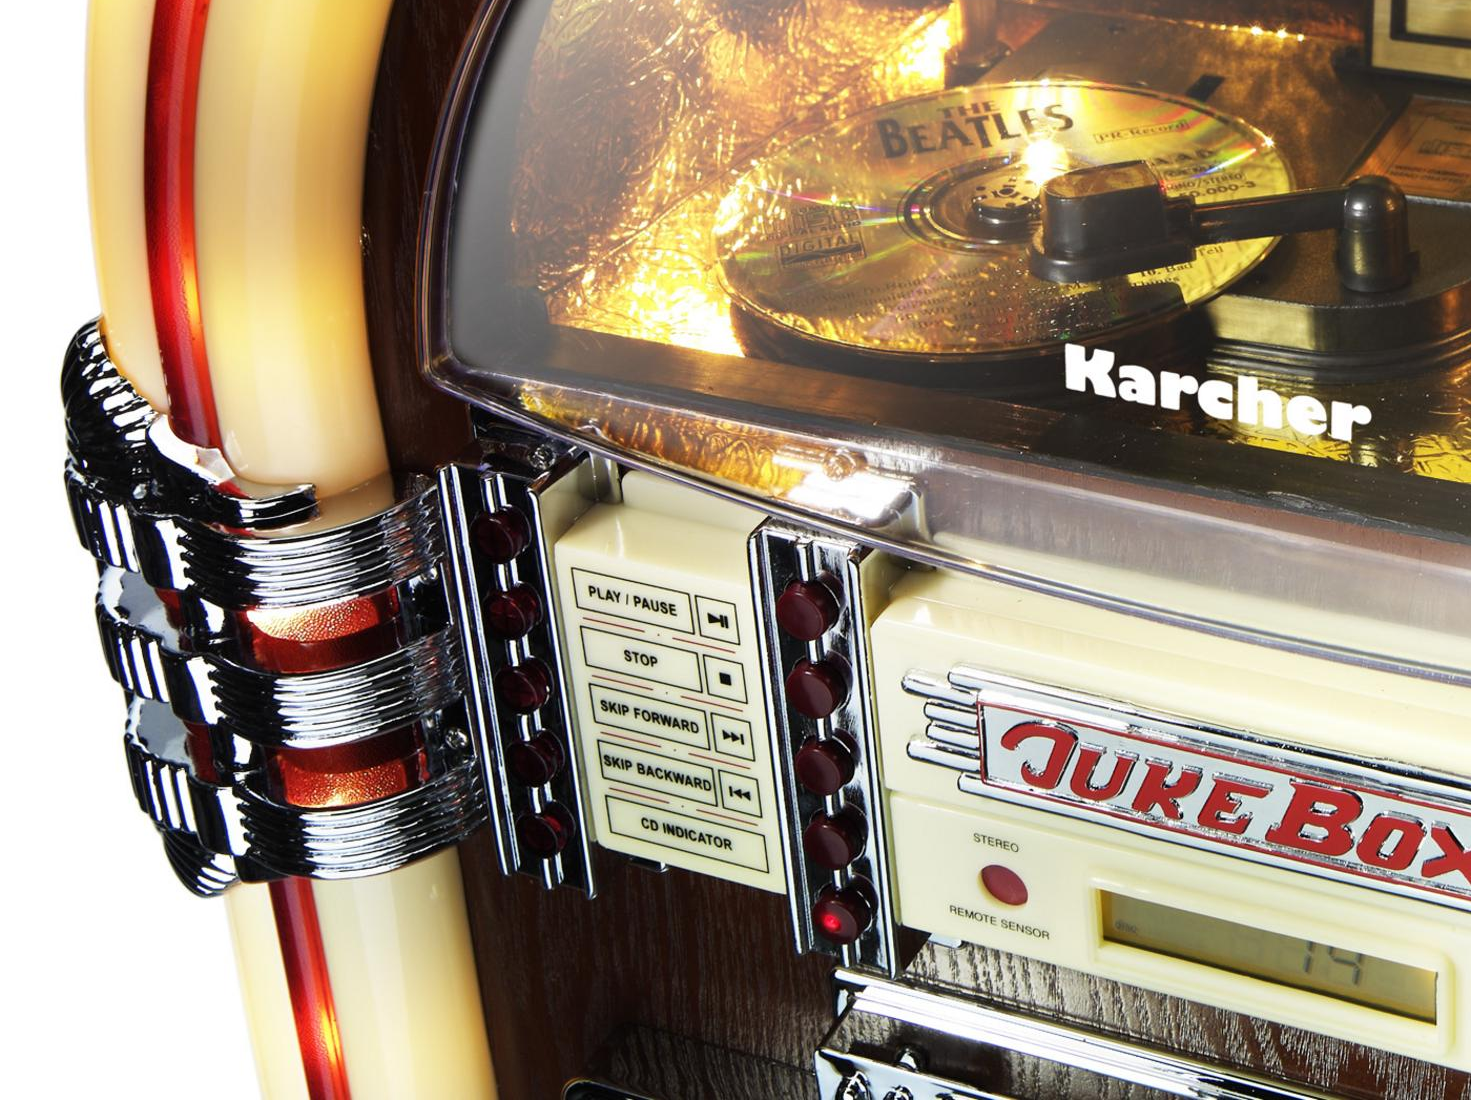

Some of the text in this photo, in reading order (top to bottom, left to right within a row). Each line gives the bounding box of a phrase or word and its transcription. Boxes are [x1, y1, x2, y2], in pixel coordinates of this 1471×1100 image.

[937, 100, 999, 119] THE
[876, 104, 1074, 159] BEATLES
[1064, 343, 1372, 442] Karcher
[588, 585, 622, 604] PLAY
[633, 595, 678, 617] PAUSE
[623, 649, 659, 668] STOP
[600, 699, 700, 735] SKIP FORWARD
[603, 754, 712, 793] SKIP BACKWARD
[640, 817, 733, 851] CD INDICATOR
[973, 832, 1020, 853] STEREO
[949, 904, 1050, 940] REMOTE SENSOR
